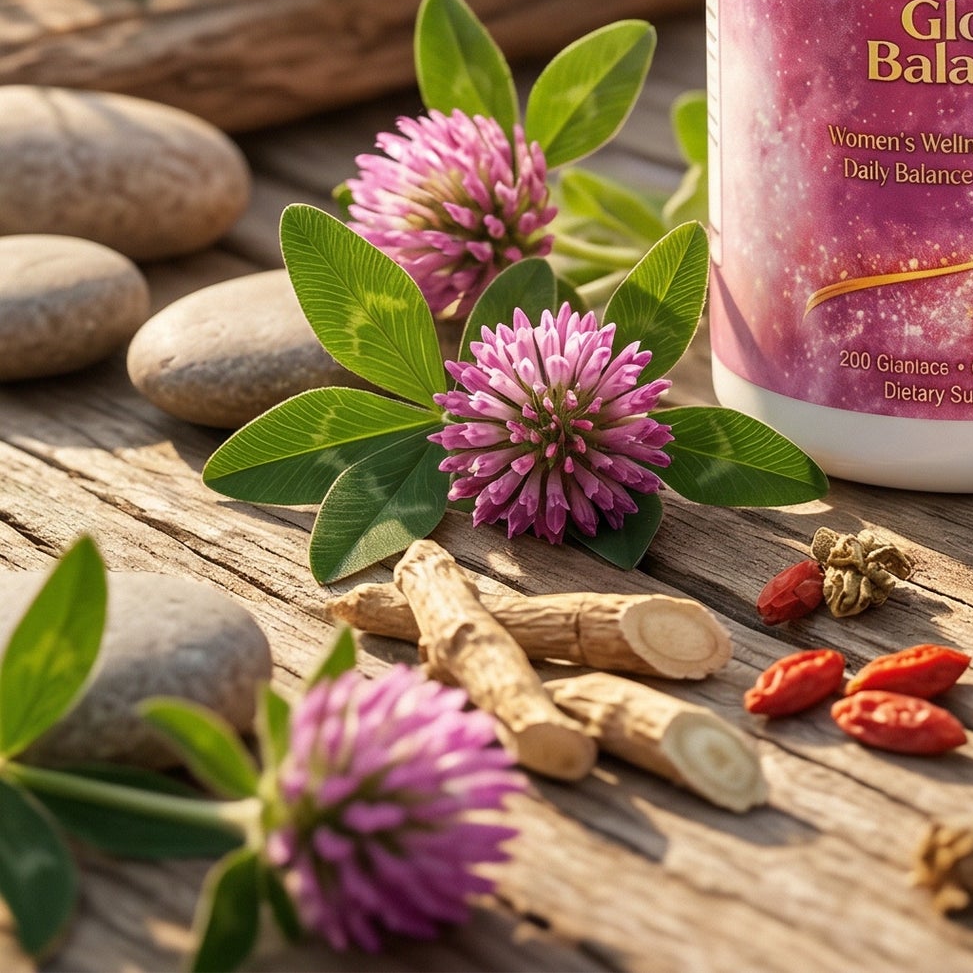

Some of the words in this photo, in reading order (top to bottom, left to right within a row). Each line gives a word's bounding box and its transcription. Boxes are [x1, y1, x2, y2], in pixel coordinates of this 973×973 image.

[828, 124, 915, 153] Women's
[844, 158, 890, 187] Daily
[839, 349, 871, 370] 200
[884, 381, 945, 407] Dietary
